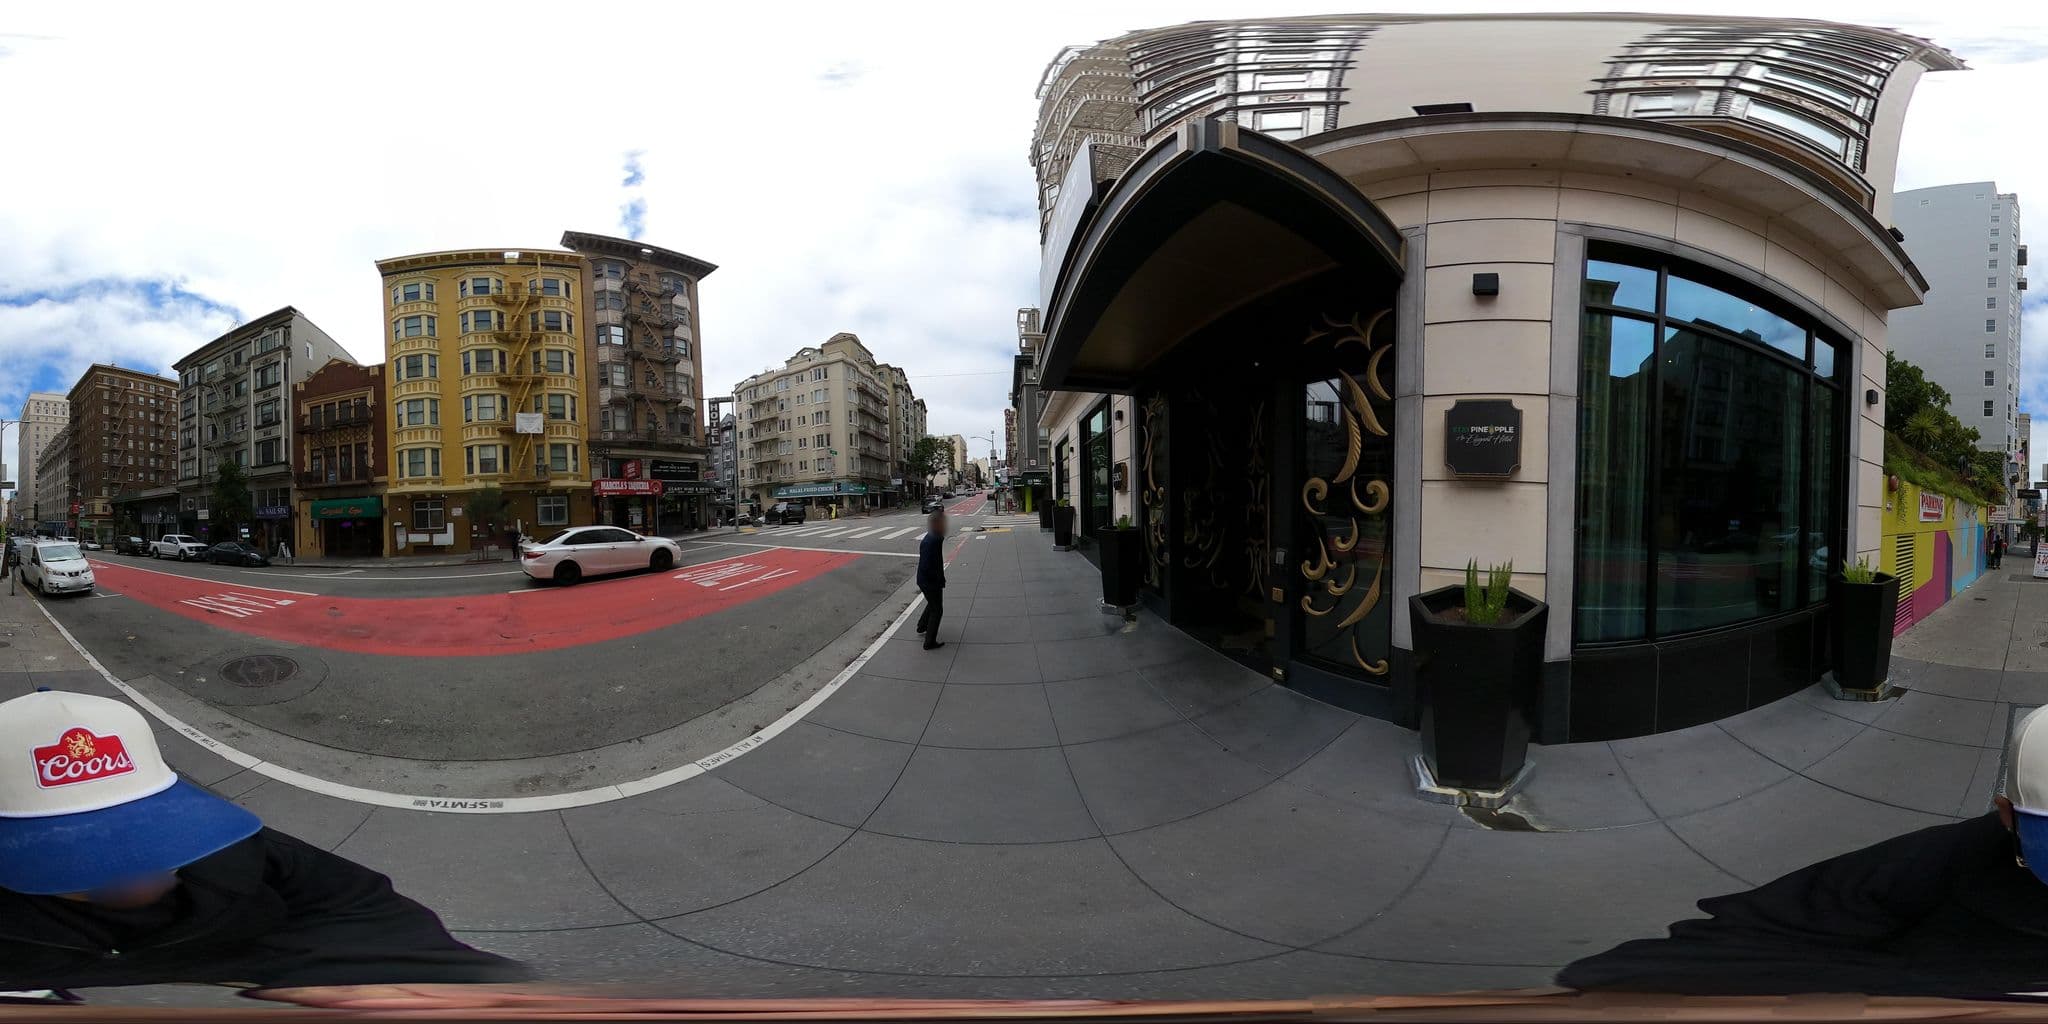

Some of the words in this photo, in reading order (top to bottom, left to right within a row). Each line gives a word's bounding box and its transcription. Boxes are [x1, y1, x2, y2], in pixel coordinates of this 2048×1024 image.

[710, 403, 719, 444] HOTEL
[1921, 494, 1943, 512] PARKING
[40, 752, 131, 781] Coors
[700, 752, 733, 768] TIMES
[430, 800, 488, 809] SFMTA
